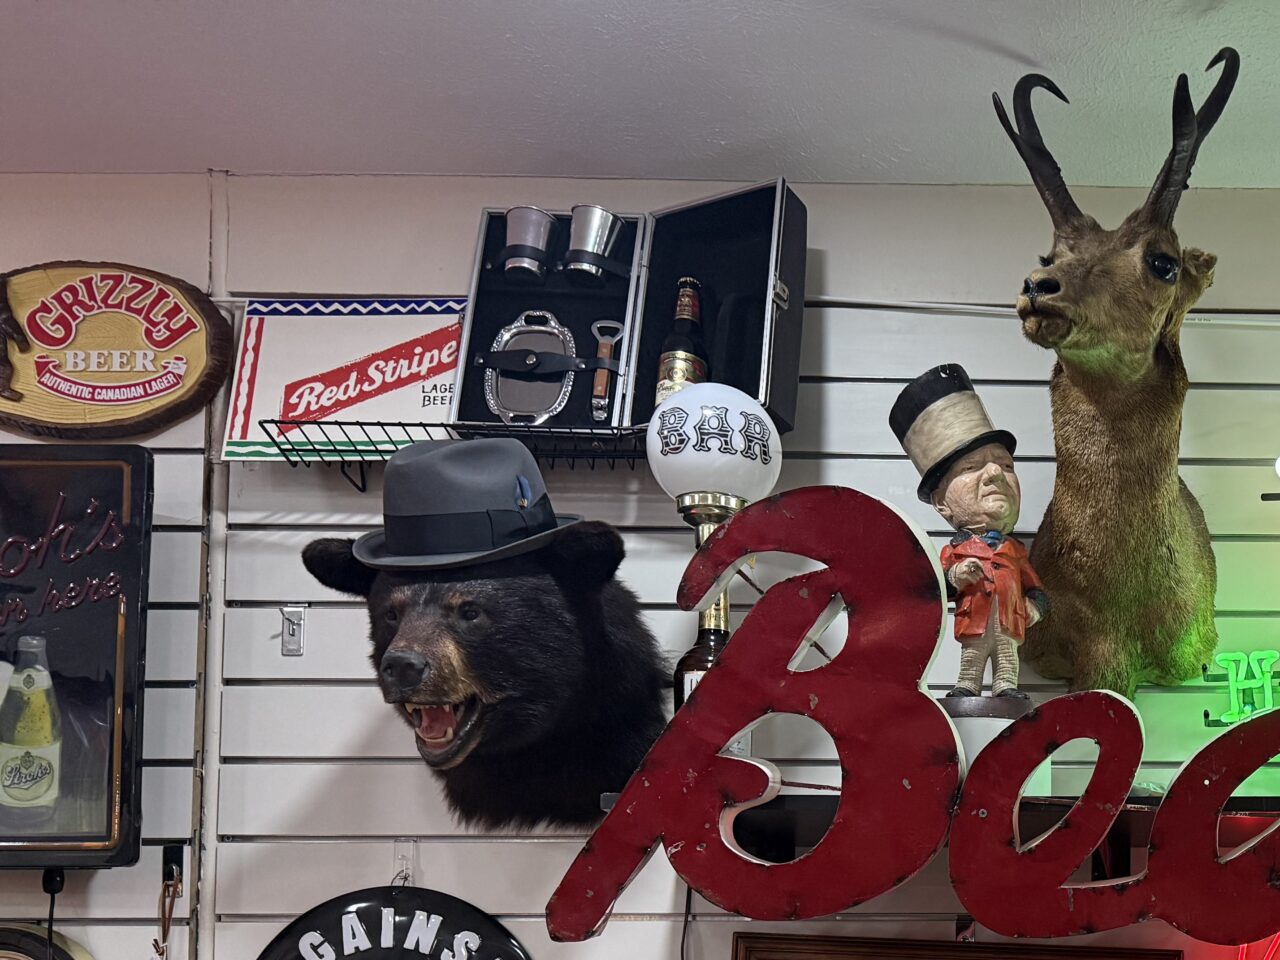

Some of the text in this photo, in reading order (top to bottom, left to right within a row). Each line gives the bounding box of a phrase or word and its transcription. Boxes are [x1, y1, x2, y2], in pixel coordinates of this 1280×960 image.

[24, 273, 200, 350] GRIZZLY
[64, 350, 157, 372] BEER
[288, 337, 458, 418] Red Stripe
[40, 372, 177, 400] AUTHENTIC CANADIAN LAGER
[422, 384, 455, 394] LAGE
[657, 405, 772, 465] BAR
